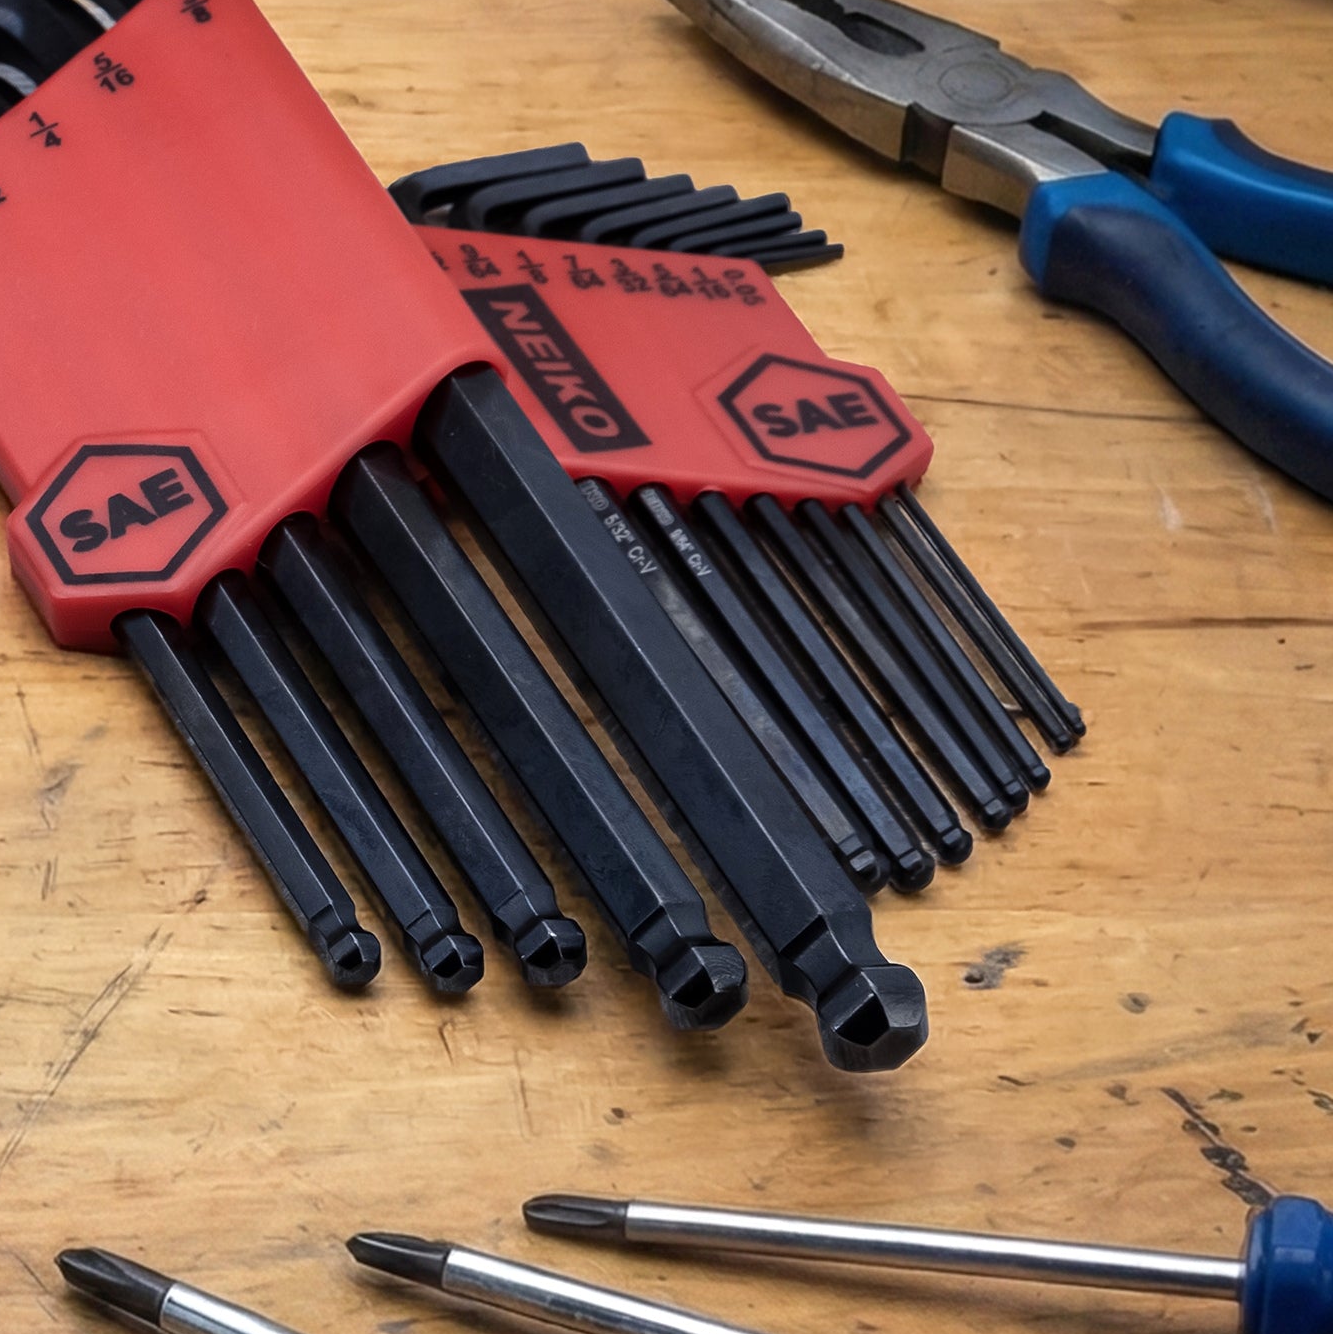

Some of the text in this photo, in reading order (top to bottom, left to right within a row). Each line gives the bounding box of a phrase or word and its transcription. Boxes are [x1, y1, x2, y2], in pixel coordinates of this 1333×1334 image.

[488, 300, 622, 440] NEIKO
[752, 392, 880, 440] SAE
[59, 468, 196, 555] SAE
[628, 546, 658, 574] Cr-V
[688, 553, 713, 576] Cr-V
